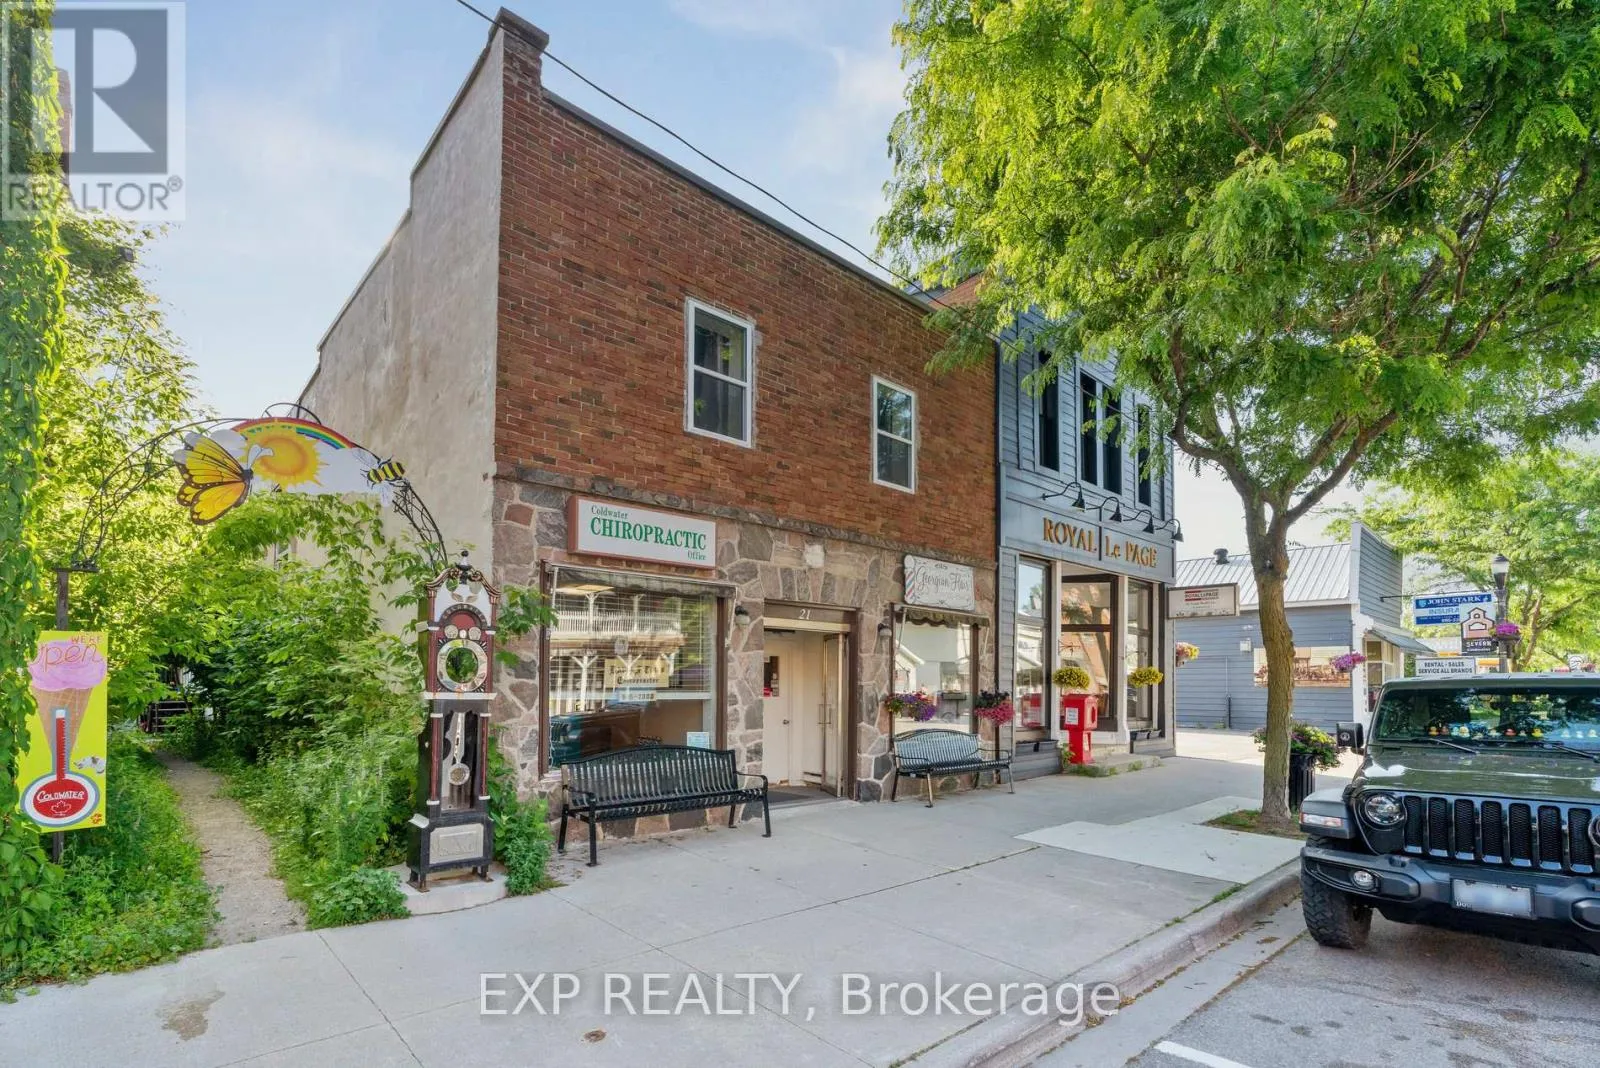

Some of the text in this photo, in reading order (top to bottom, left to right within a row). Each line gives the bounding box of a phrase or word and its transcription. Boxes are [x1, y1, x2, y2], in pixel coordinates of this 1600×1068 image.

[590, 504, 628, 519] Coldwater
[590, 516, 706, 550] CHIROPRACTIC
[1043, 517, 1157, 568] ROYAL Le PAGE
[687, 549, 706, 561] Office
[1451, 595, 1481, 603] STARK
[799, 608, 810, 620] 21
[1466, 640, 1492, 648] SEVERN
[33, 643, 103, 672] pen
[37, 790, 85, 803] COLDWATER
